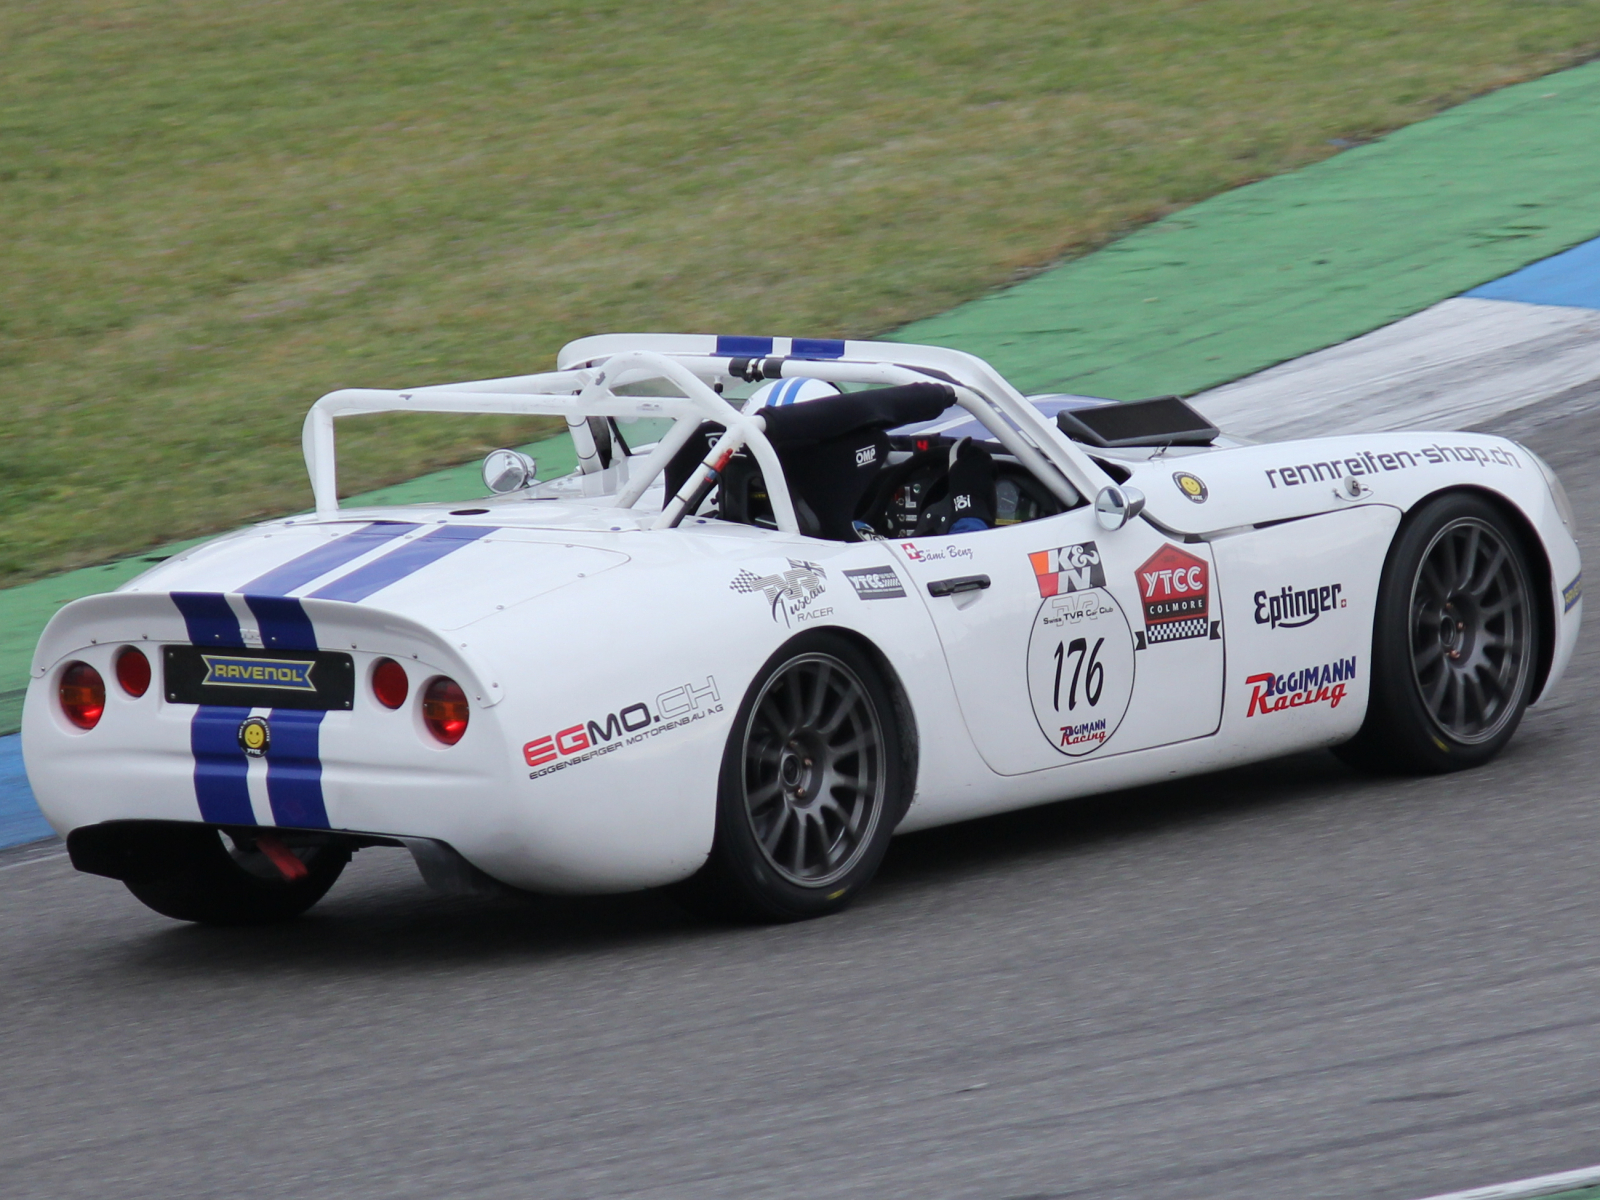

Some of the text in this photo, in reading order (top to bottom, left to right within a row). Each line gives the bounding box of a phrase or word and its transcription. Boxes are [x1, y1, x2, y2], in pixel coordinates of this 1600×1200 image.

[855, 447, 876, 464] OMP
[1264, 443, 1523, 488] rennreifen-shop.ch
[946, 544, 974, 560] Benz
[848, 573, 885, 589] YTCC
[1142, 565, 1204, 598] YTCC
[771, 583, 827, 629] Tuscan
[796, 606, 835, 623] RACER
[1063, 610, 1084, 621] TVR
[1149, 599, 1204, 615] COLMORE
[1254, 583, 1342, 630] Eptinger
[214, 664, 303, 682] RAVENOL
[1053, 636, 1106, 713] 176
[1245, 672, 1348, 718] Racing
[522, 675, 721, 768] EGMO.CH
[529, 703, 724, 780] EGGENBERGER MOTORENBAU AG
